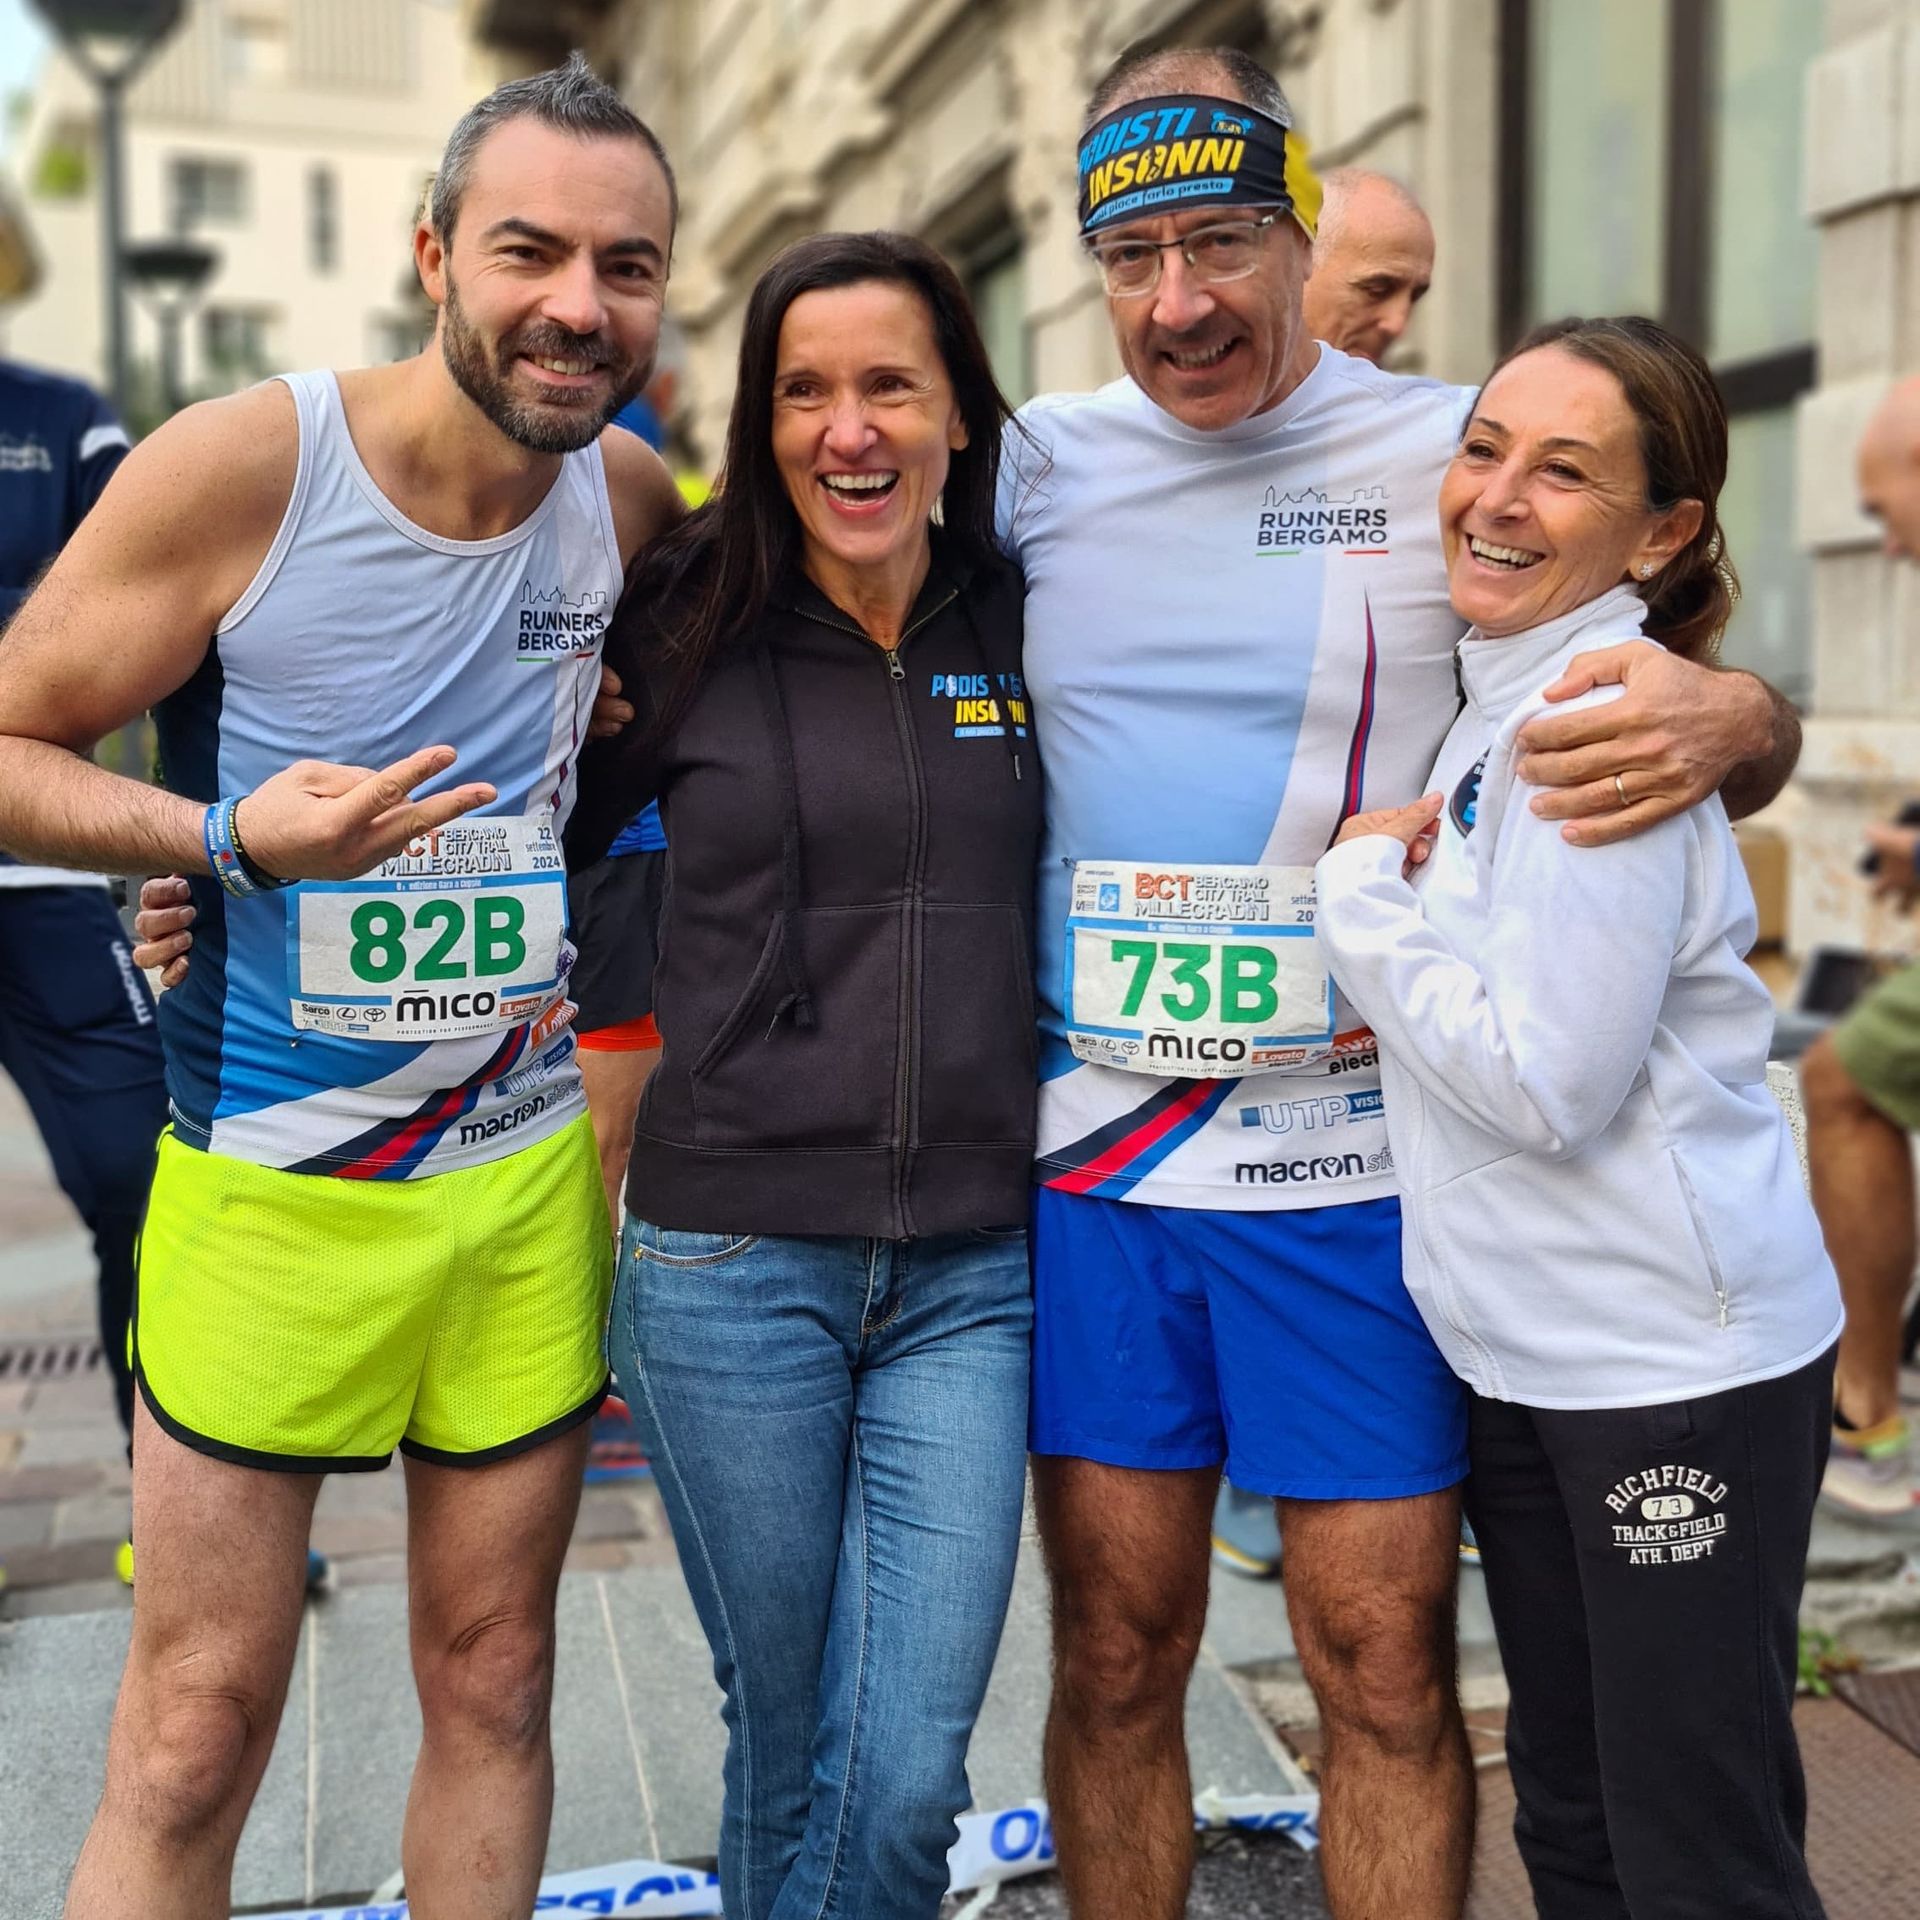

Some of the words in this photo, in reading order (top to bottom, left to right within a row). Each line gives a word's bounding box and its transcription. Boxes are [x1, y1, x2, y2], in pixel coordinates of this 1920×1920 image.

[1089, 138, 1245, 209] INSONNI
[1142, 187, 1174, 206] farlo
[1178, 182, 1225, 200] presto
[1259, 508, 1387, 529] RUNNERS
[1257, 529, 1387, 547] BERGAMO
[519, 610, 605, 632] RUNNERS
[517, 632, 596, 651] BERGAM
[930, 673, 1006, 698] PODISI
[955, 699, 1026, 724] INSONI
[402, 829, 445, 857] CT
[538, 827, 552, 840] 22
[532, 856, 560, 869] 2024
[1135, 871, 1194, 901] BCT
[350, 896, 526, 983] 82B
[1111, 939, 1279, 1024] 73B
[302, 1003, 330, 1016] Sarco
[397, 990, 495, 1021] mico
[507, 1000, 540, 1014] Lovato
[542, 1005, 575, 1038] Lovato
[1148, 1028, 1246, 1062] mico
[1262, 1051, 1304, 1061] Lovato
[502, 1058, 545, 1098] UTP
[460, 1095, 545, 1145] macron
[1261, 1095, 1349, 1134] UTP
[1235, 1153, 1365, 1183] macron
[1604, 1464, 1729, 1515] RICHFIELD
[1629, 1548, 1668, 1565] ATH.
[1670, 1539, 1715, 1563] DEPT
